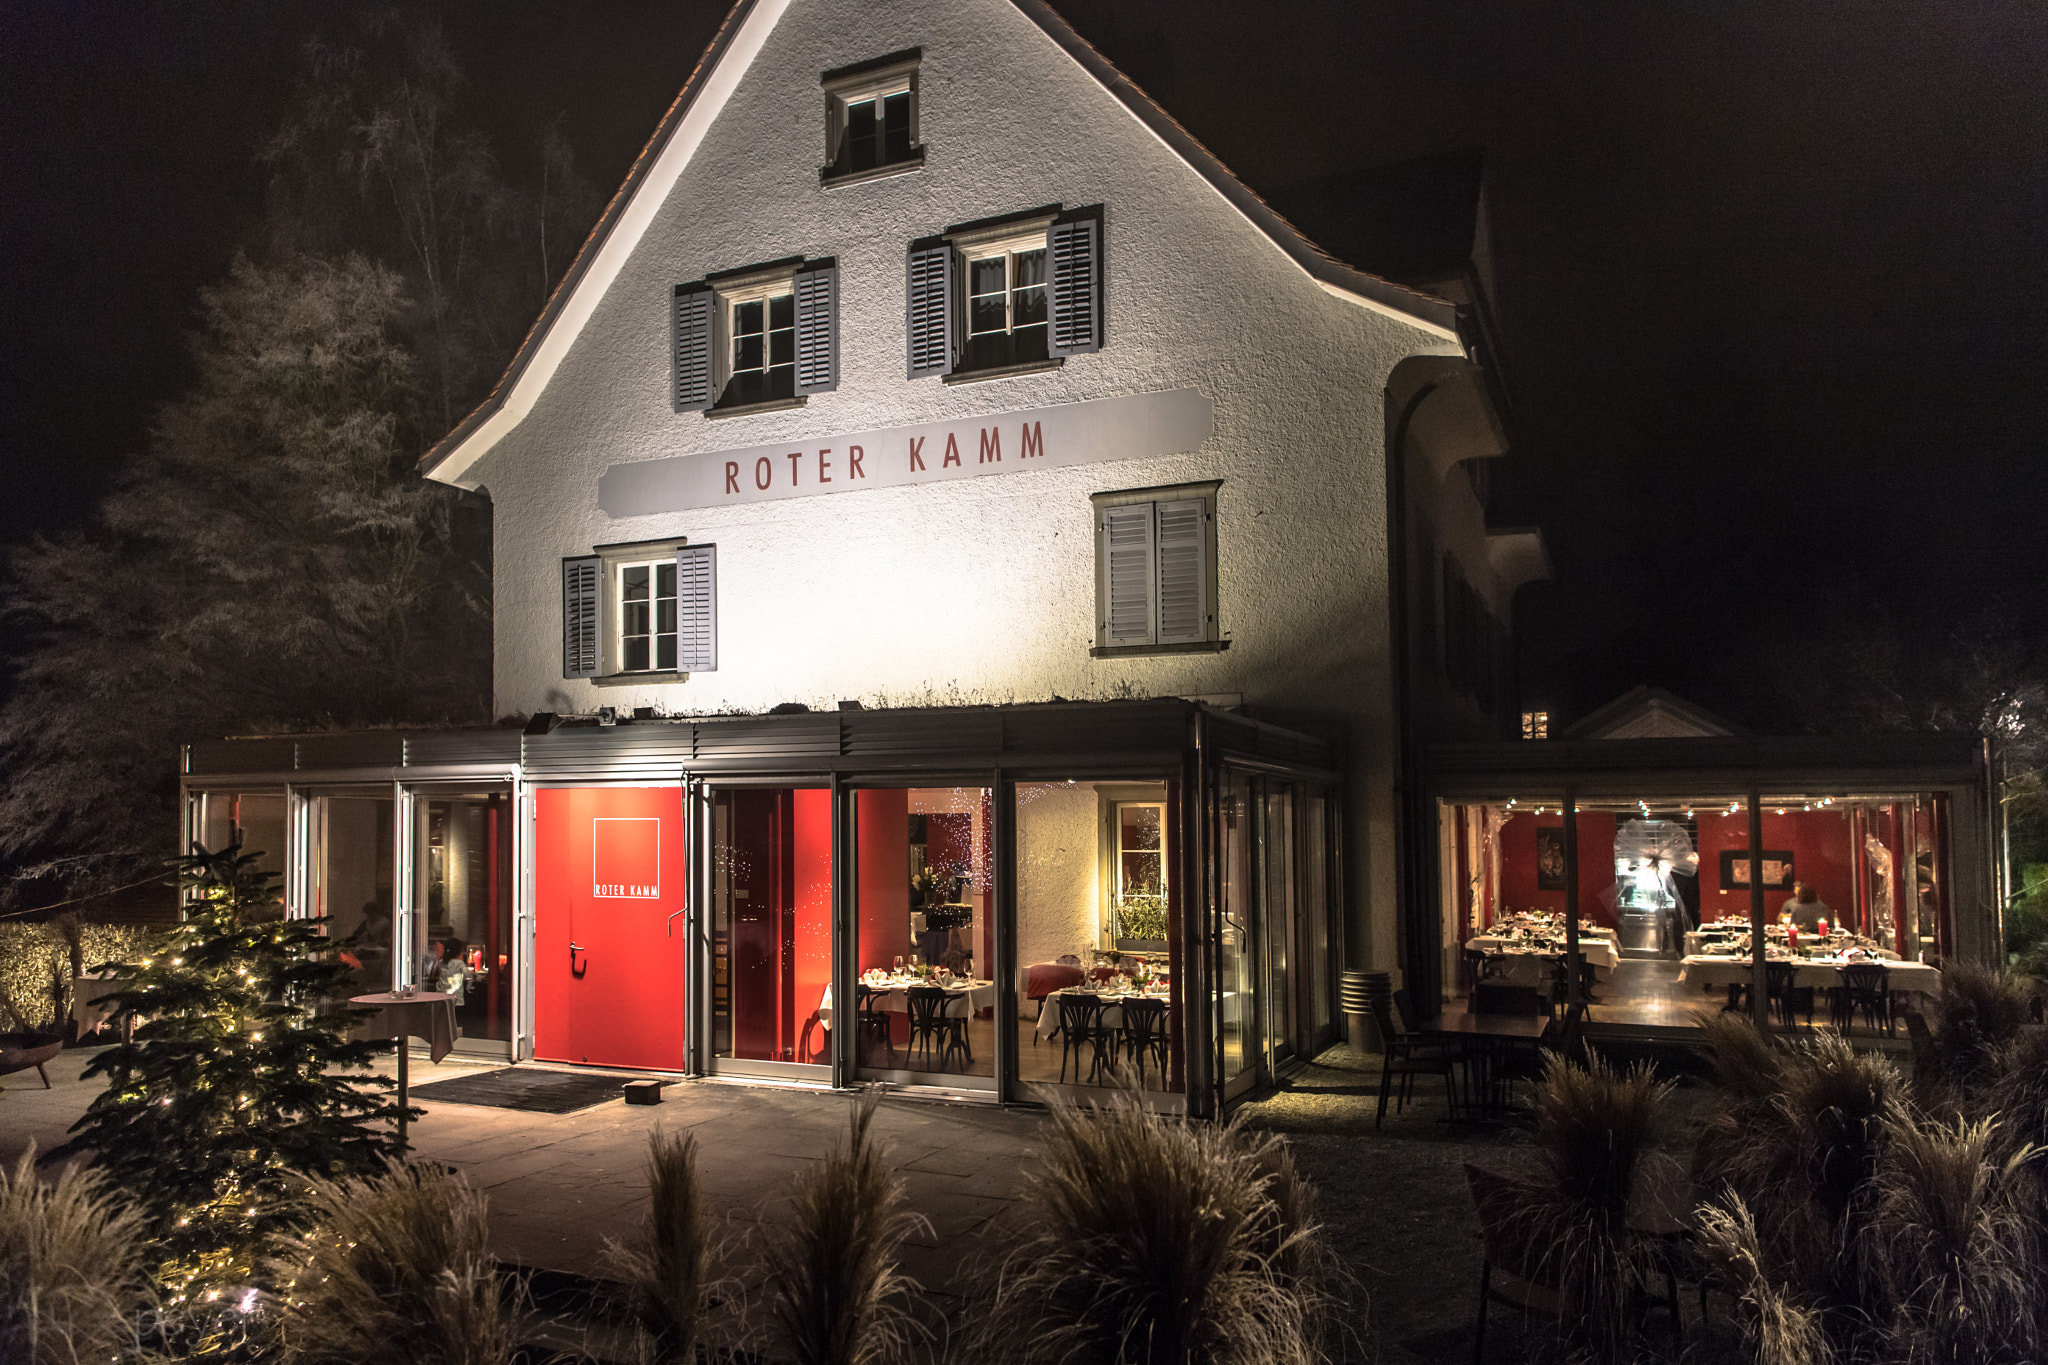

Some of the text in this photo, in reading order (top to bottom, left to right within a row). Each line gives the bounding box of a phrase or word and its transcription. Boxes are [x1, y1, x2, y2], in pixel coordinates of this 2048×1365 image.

[726, 421, 1044, 495] ROTER KAMM
[595, 884, 658, 897] ROTER KAMM
